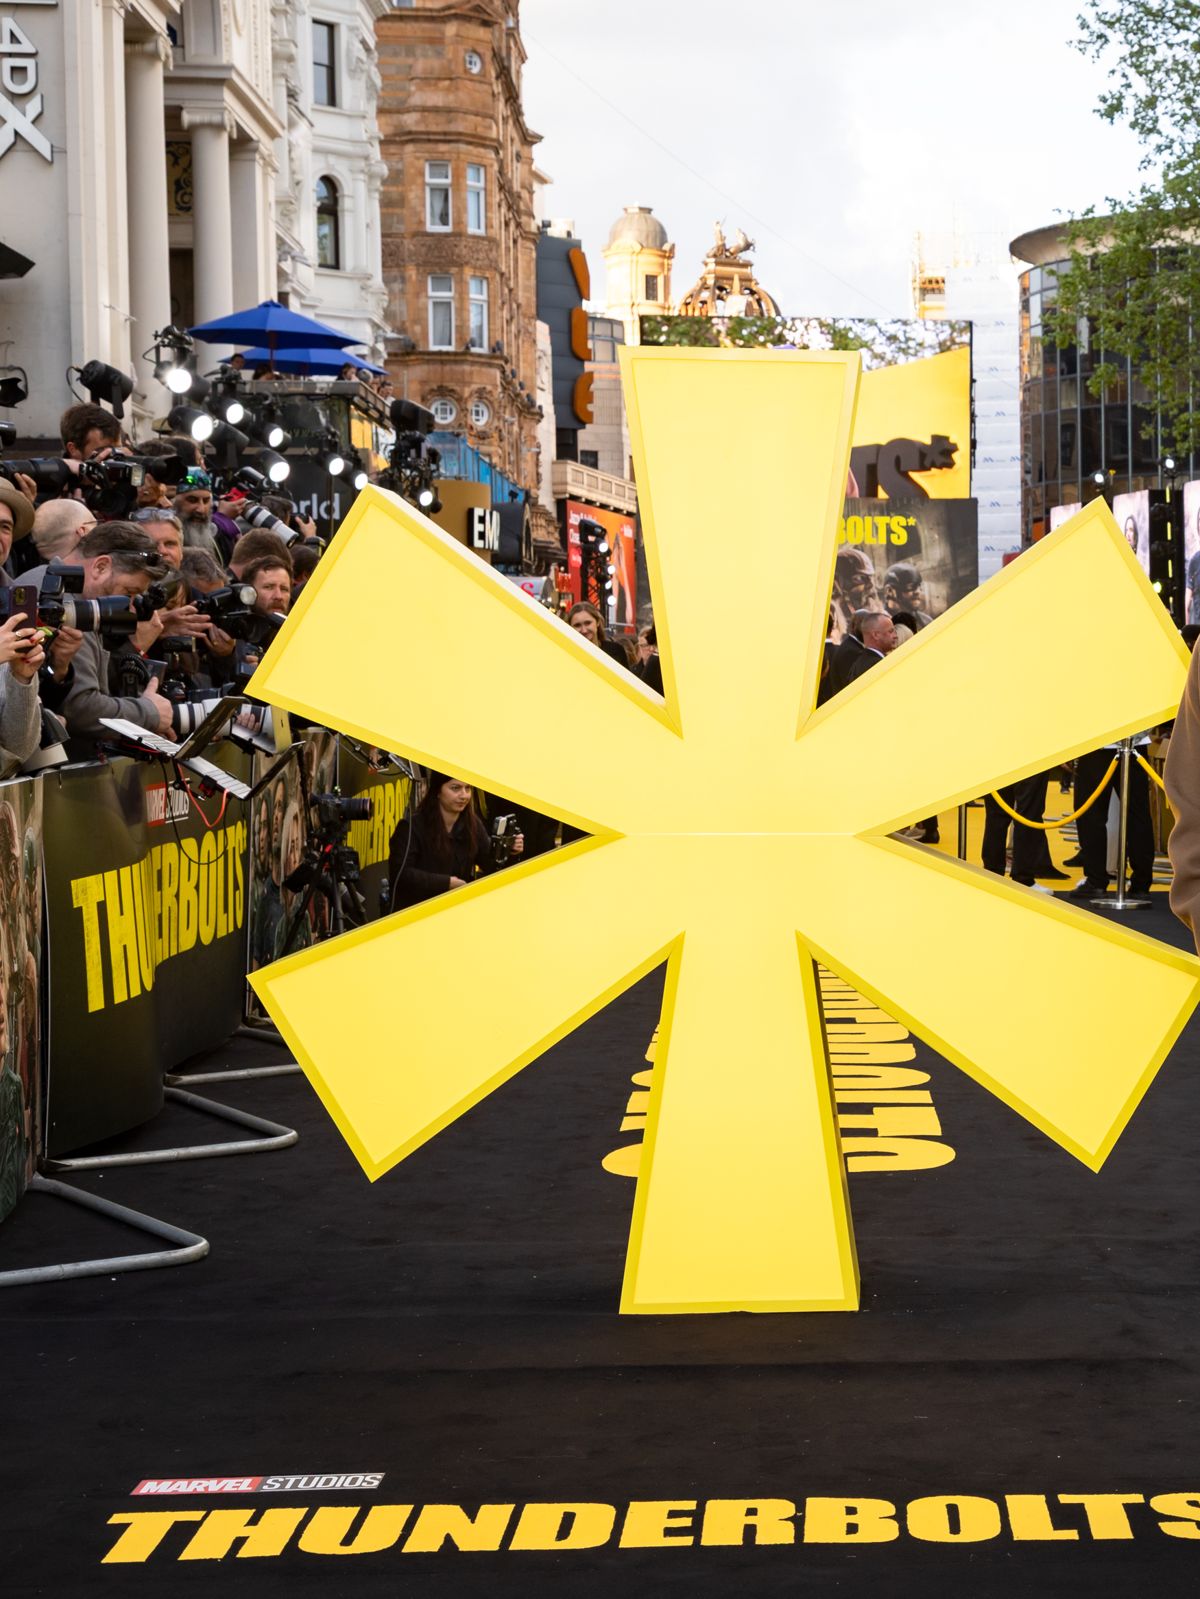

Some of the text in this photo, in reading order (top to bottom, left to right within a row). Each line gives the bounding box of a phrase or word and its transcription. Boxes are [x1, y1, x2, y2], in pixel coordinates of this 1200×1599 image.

[0, 17, 53, 164] 4DX
[139, 1474, 384, 1494] MARVEL STUDIOS
